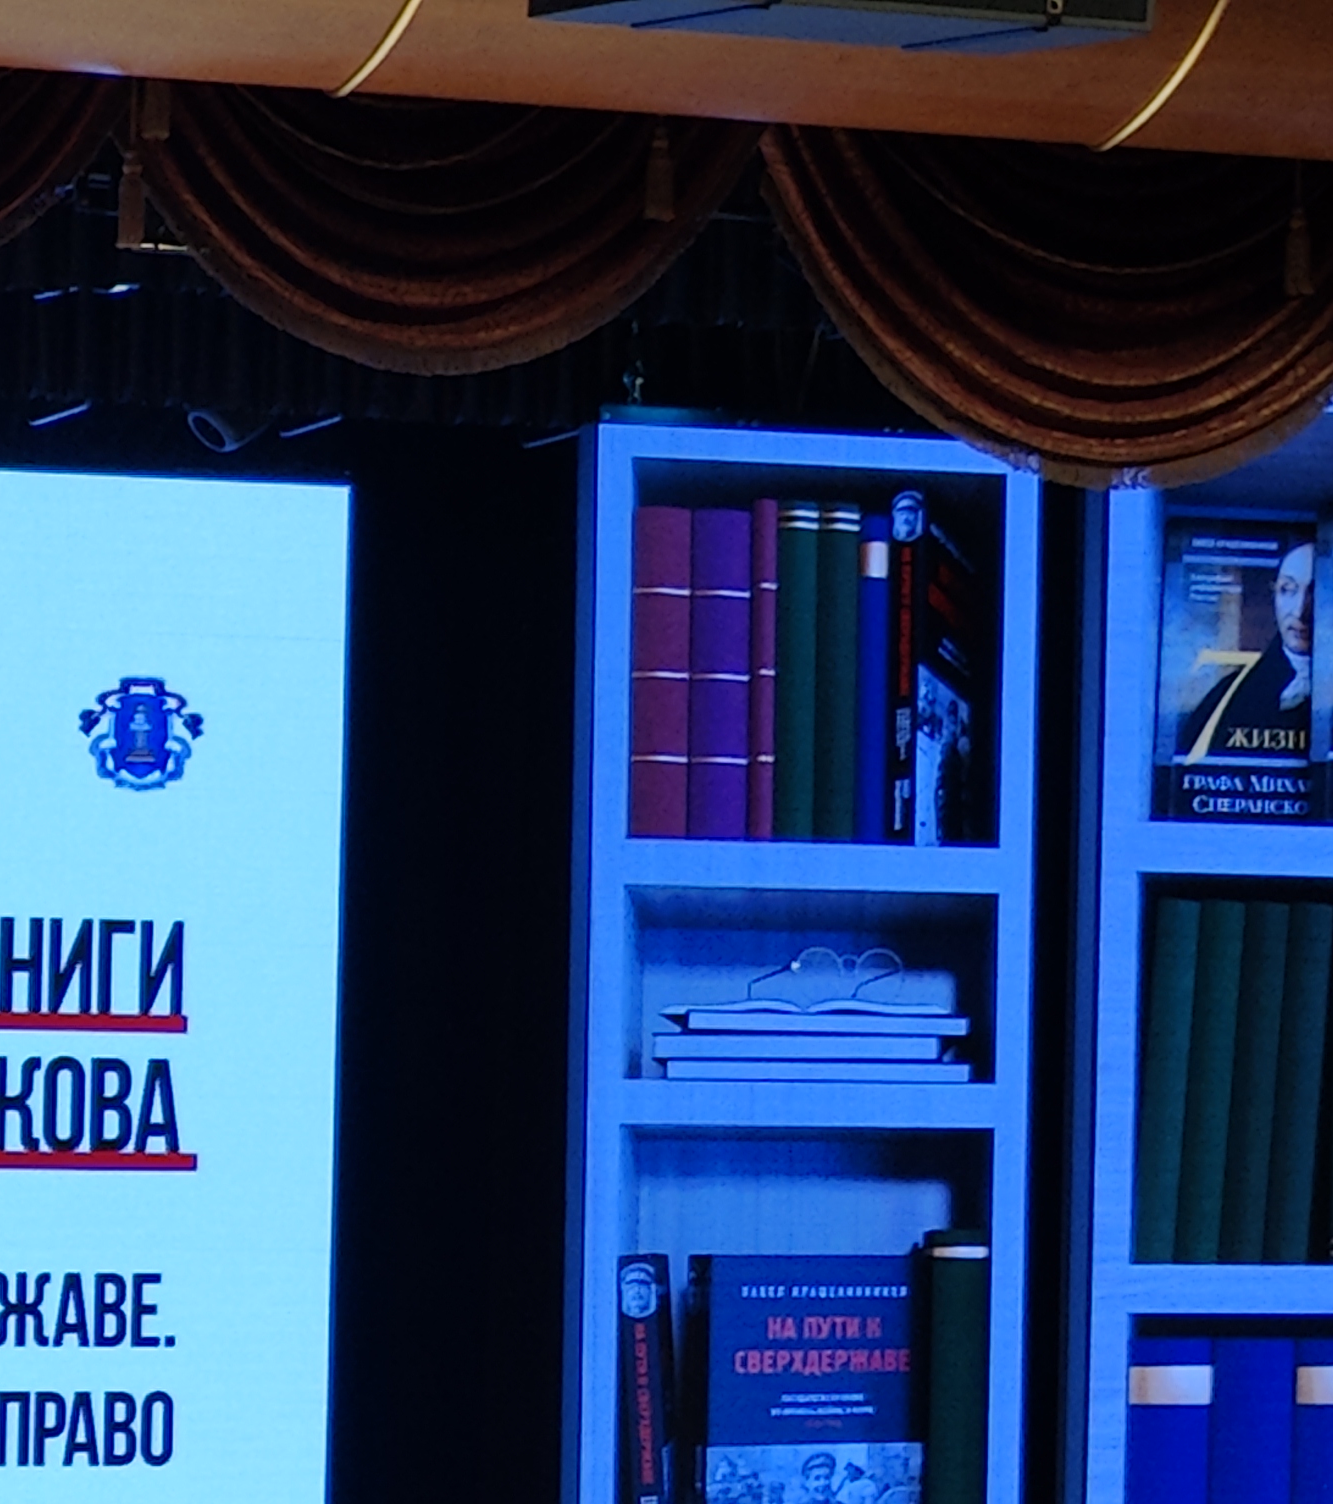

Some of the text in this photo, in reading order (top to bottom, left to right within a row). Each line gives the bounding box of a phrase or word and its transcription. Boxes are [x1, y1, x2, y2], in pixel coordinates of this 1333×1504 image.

[1191, 650, 1263, 767] 7
[767, 1316, 883, 1341] НА ПУТИ К
[733, 1348, 912, 1377] СВЕРХДЕРЖАВЕ
